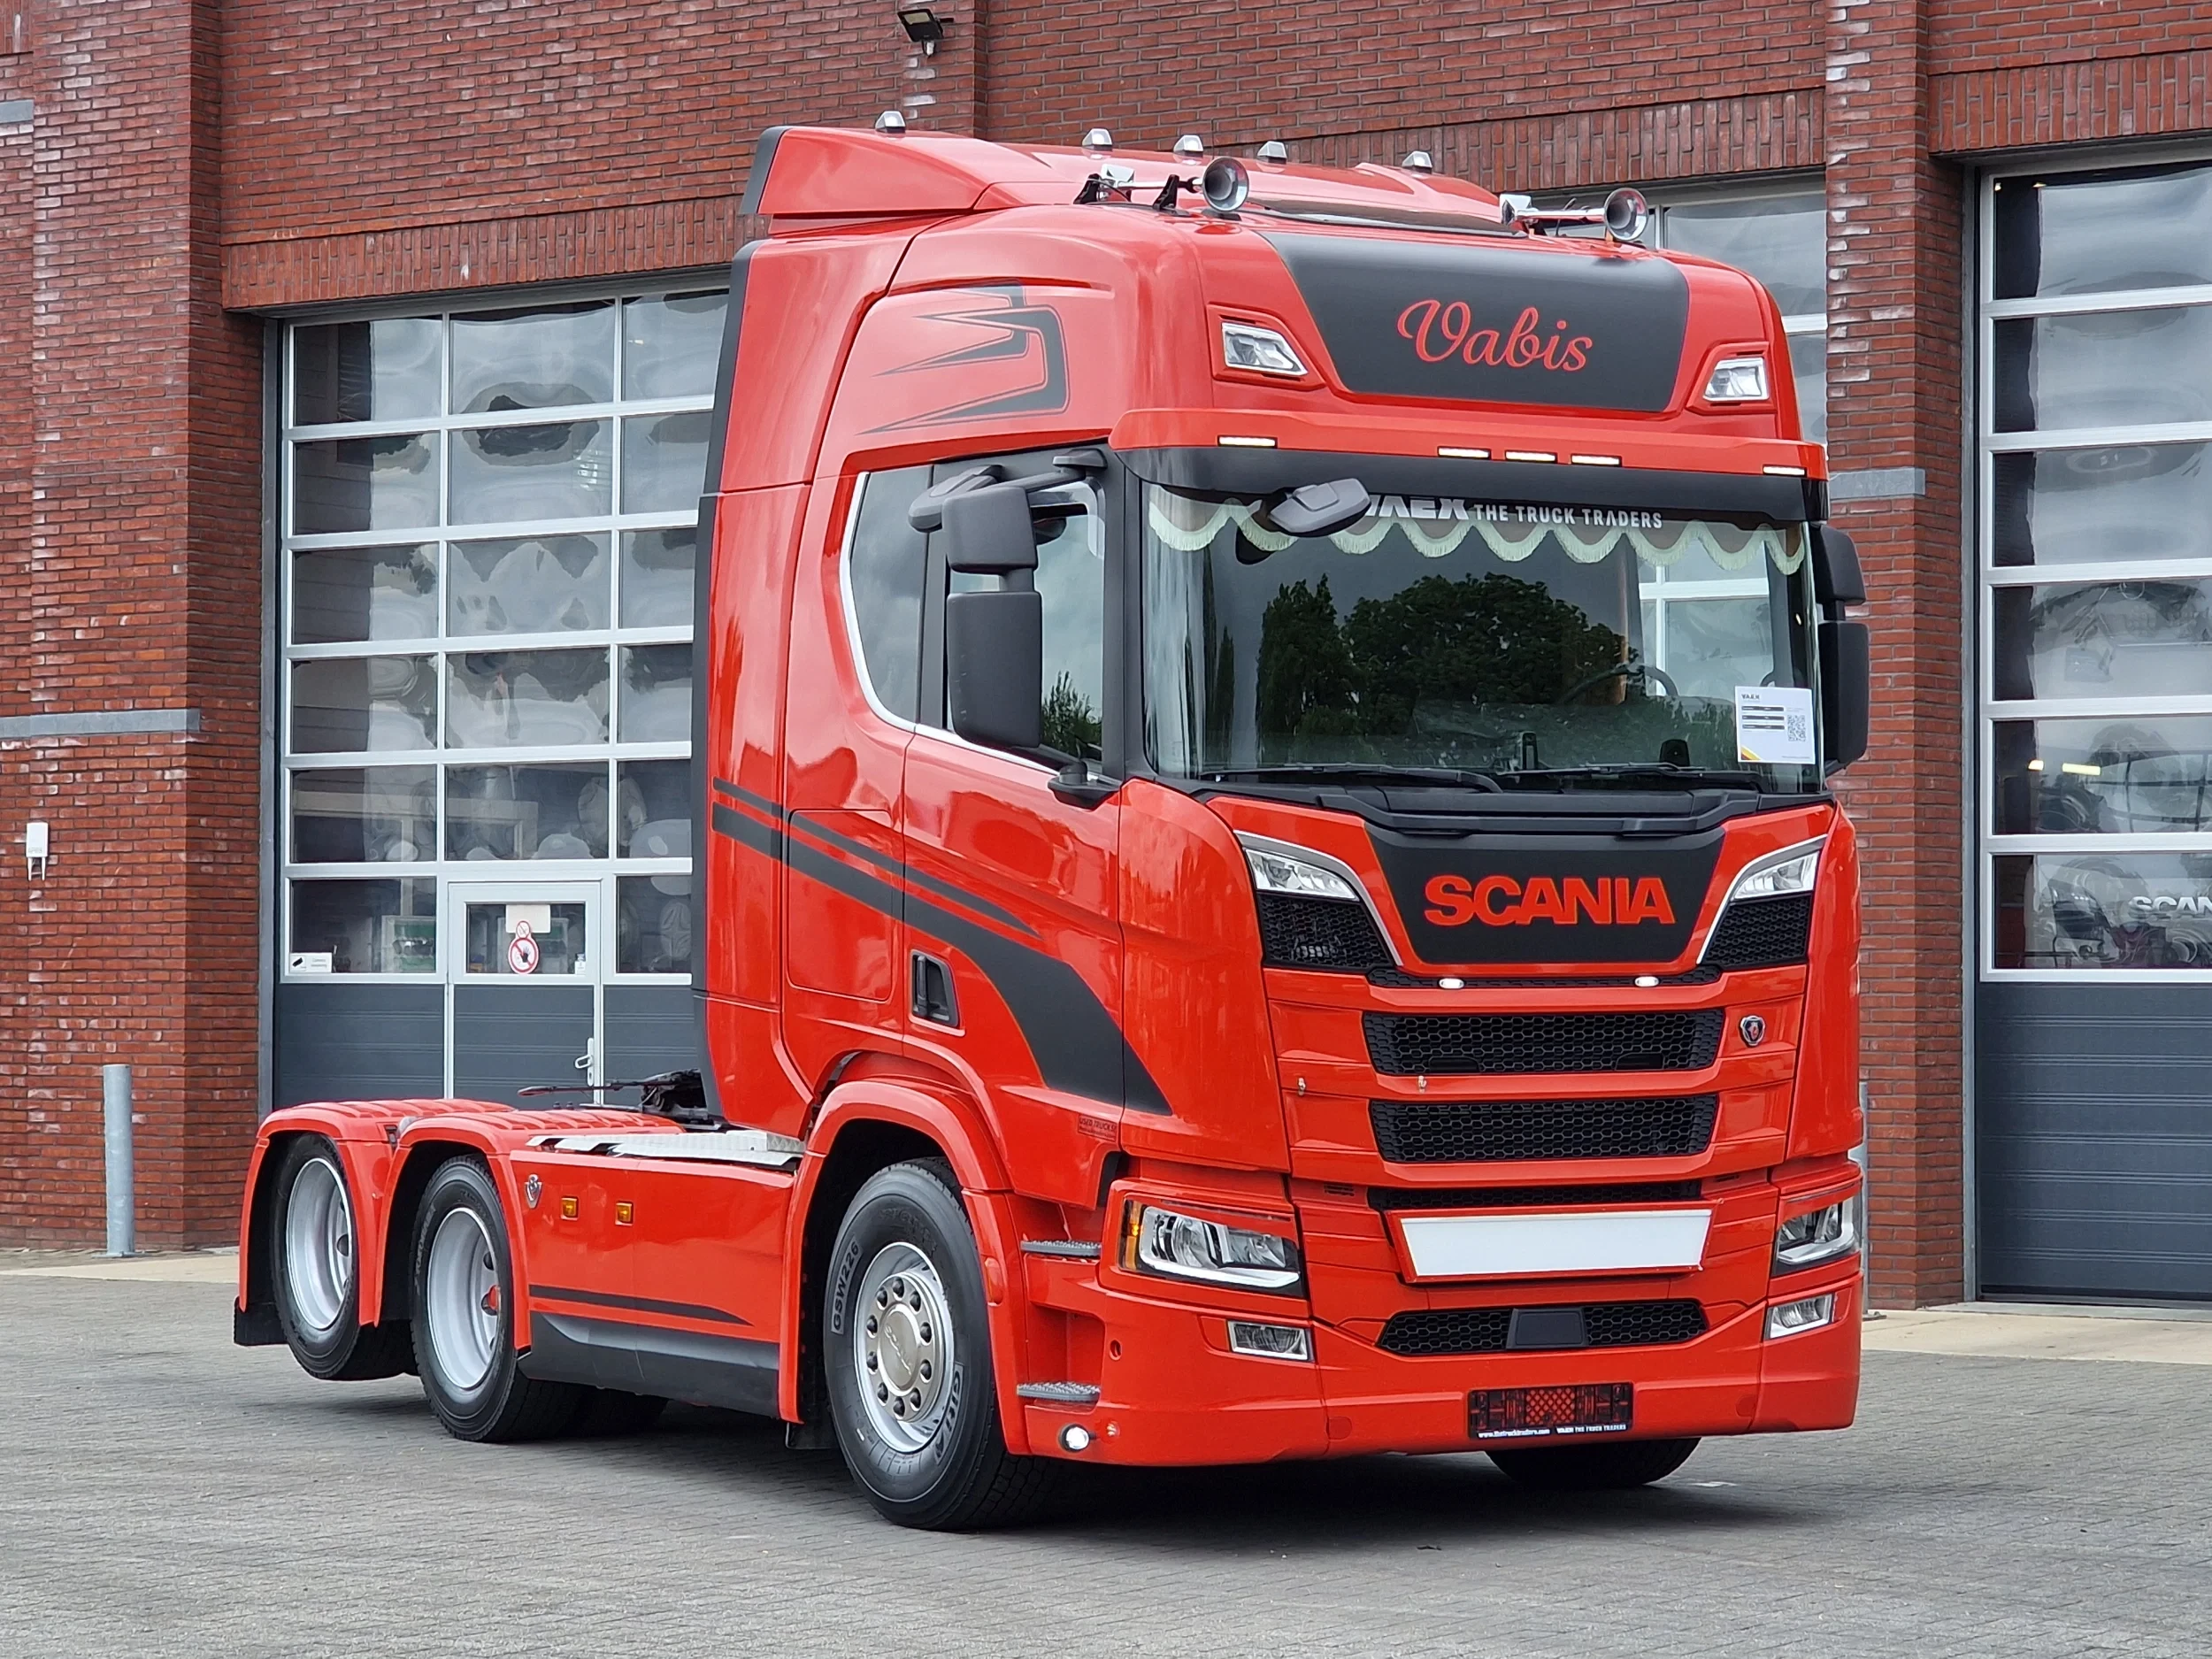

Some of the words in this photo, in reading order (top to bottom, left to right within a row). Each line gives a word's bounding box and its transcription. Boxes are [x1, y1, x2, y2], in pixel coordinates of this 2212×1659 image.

[1397, 299, 1593, 372] Vabis
[1474, 503, 1509, 522] THE
[1515, 505, 1577, 525] TRUCK
[1582, 508, 1663, 529] TRADERS
[1424, 874, 1676, 926] SCANIA
[833, 1241, 859, 1331] GSW226
